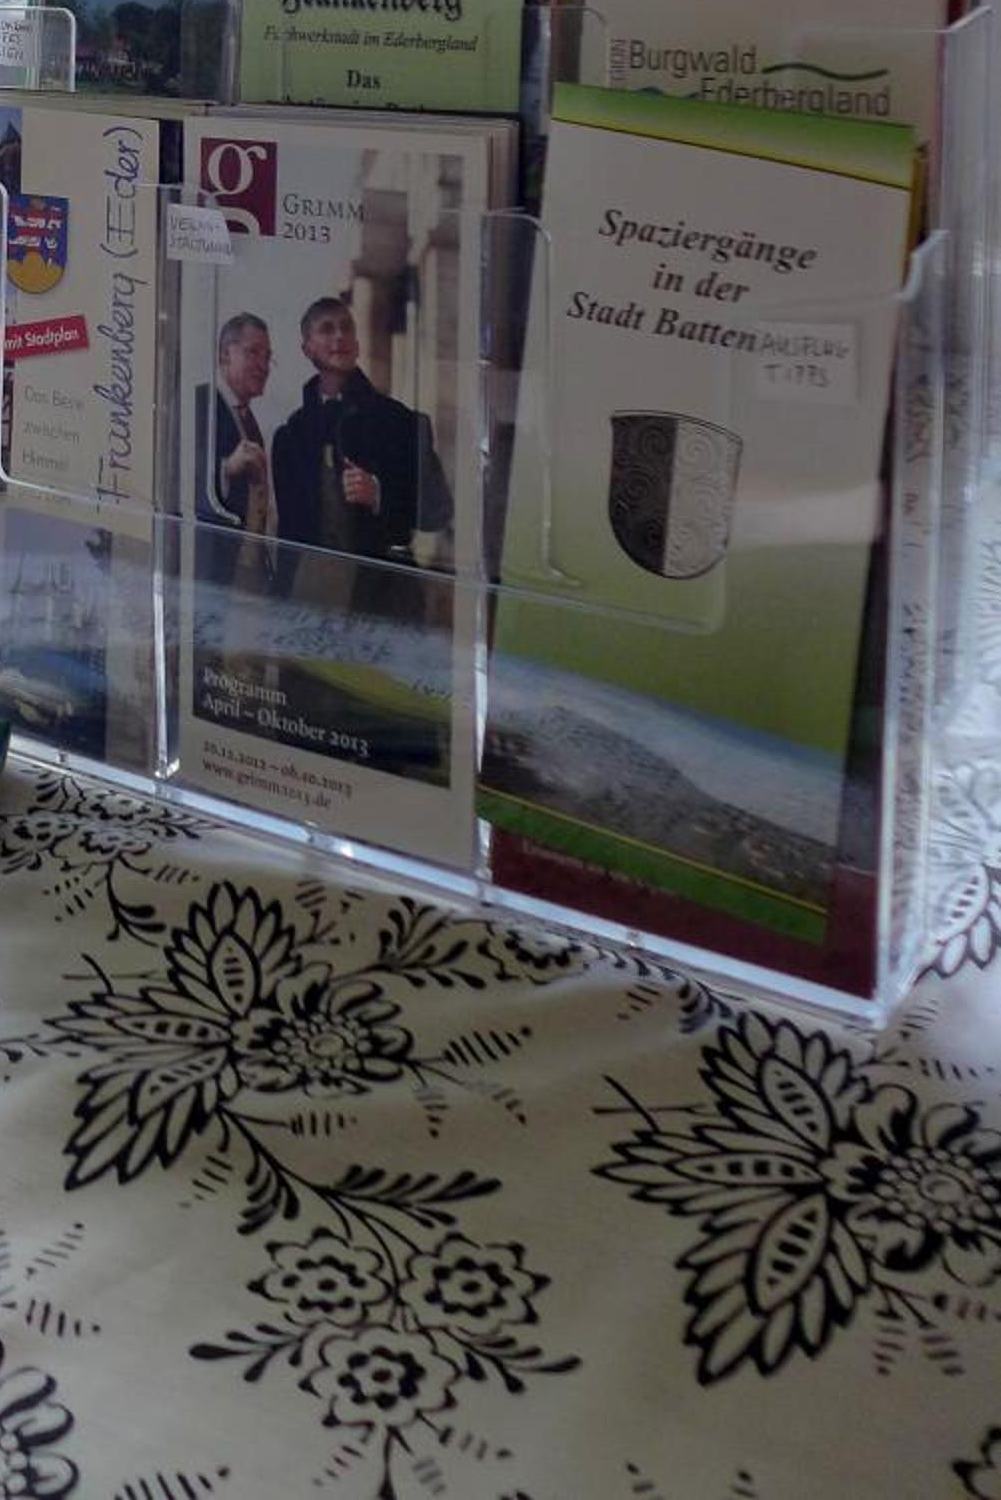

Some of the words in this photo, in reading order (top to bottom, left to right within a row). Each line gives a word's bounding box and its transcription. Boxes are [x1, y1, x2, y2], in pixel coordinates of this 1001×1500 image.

[629, 39, 757, 79] Burgwald
[346, 69, 381, 90] Das
[283, 222, 331, 244] 2013
[599, 209, 818, 274] Spaziergänge
[652, 263, 684, 293] in
[695, 272, 751, 303] der
[567, 291, 646, 330] Stadt
[203, 666, 287, 706] Programm
[203, 692, 241, 718] April
[257, 707, 327, 742] Oktober
[329, 730, 371, 759] 2013
